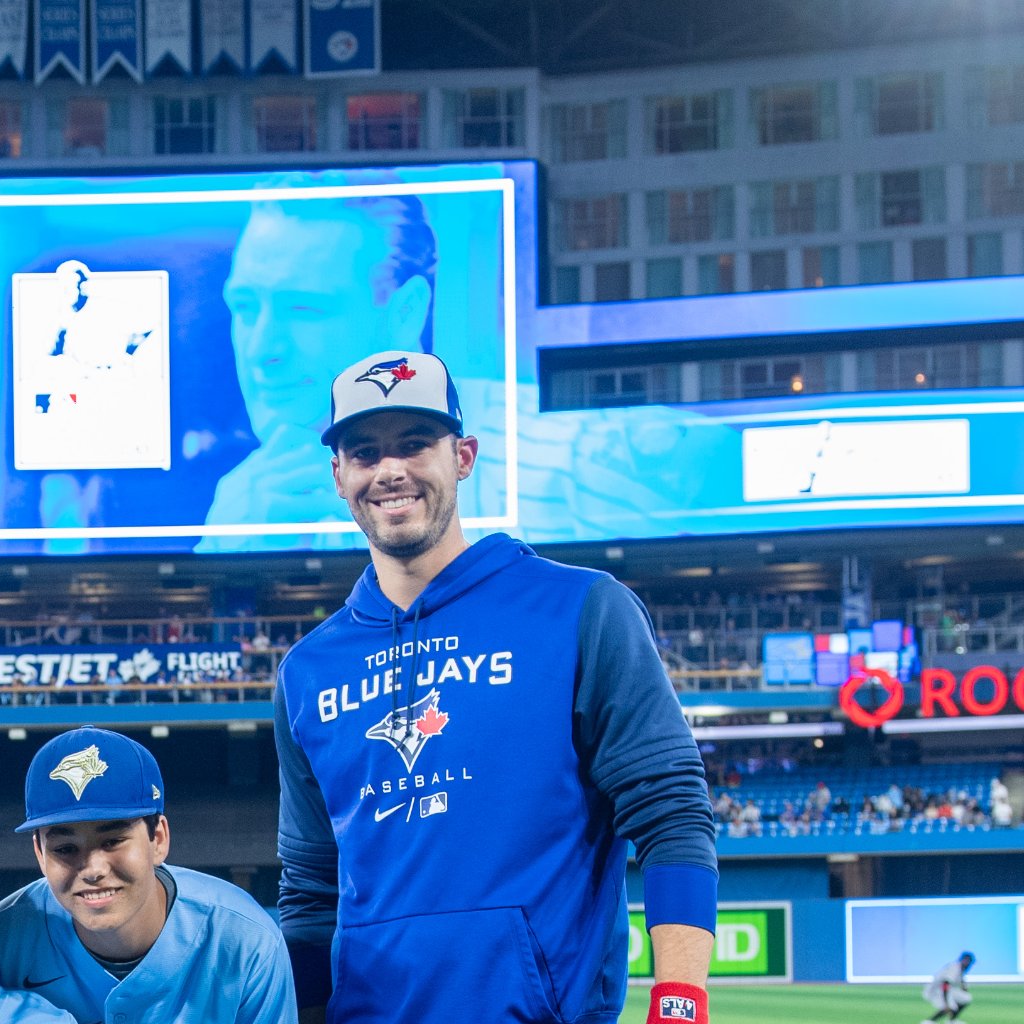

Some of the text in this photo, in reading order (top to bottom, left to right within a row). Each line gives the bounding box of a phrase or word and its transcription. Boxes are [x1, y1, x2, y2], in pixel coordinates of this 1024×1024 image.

[167, 652, 241, 671] FLIGHT
[365, 636, 459, 669] TORONTO
[318, 651, 513, 722] BLUE JAYS
[920, 665, 1024, 718] RO
[360, 767, 473, 799] BASEBALL
